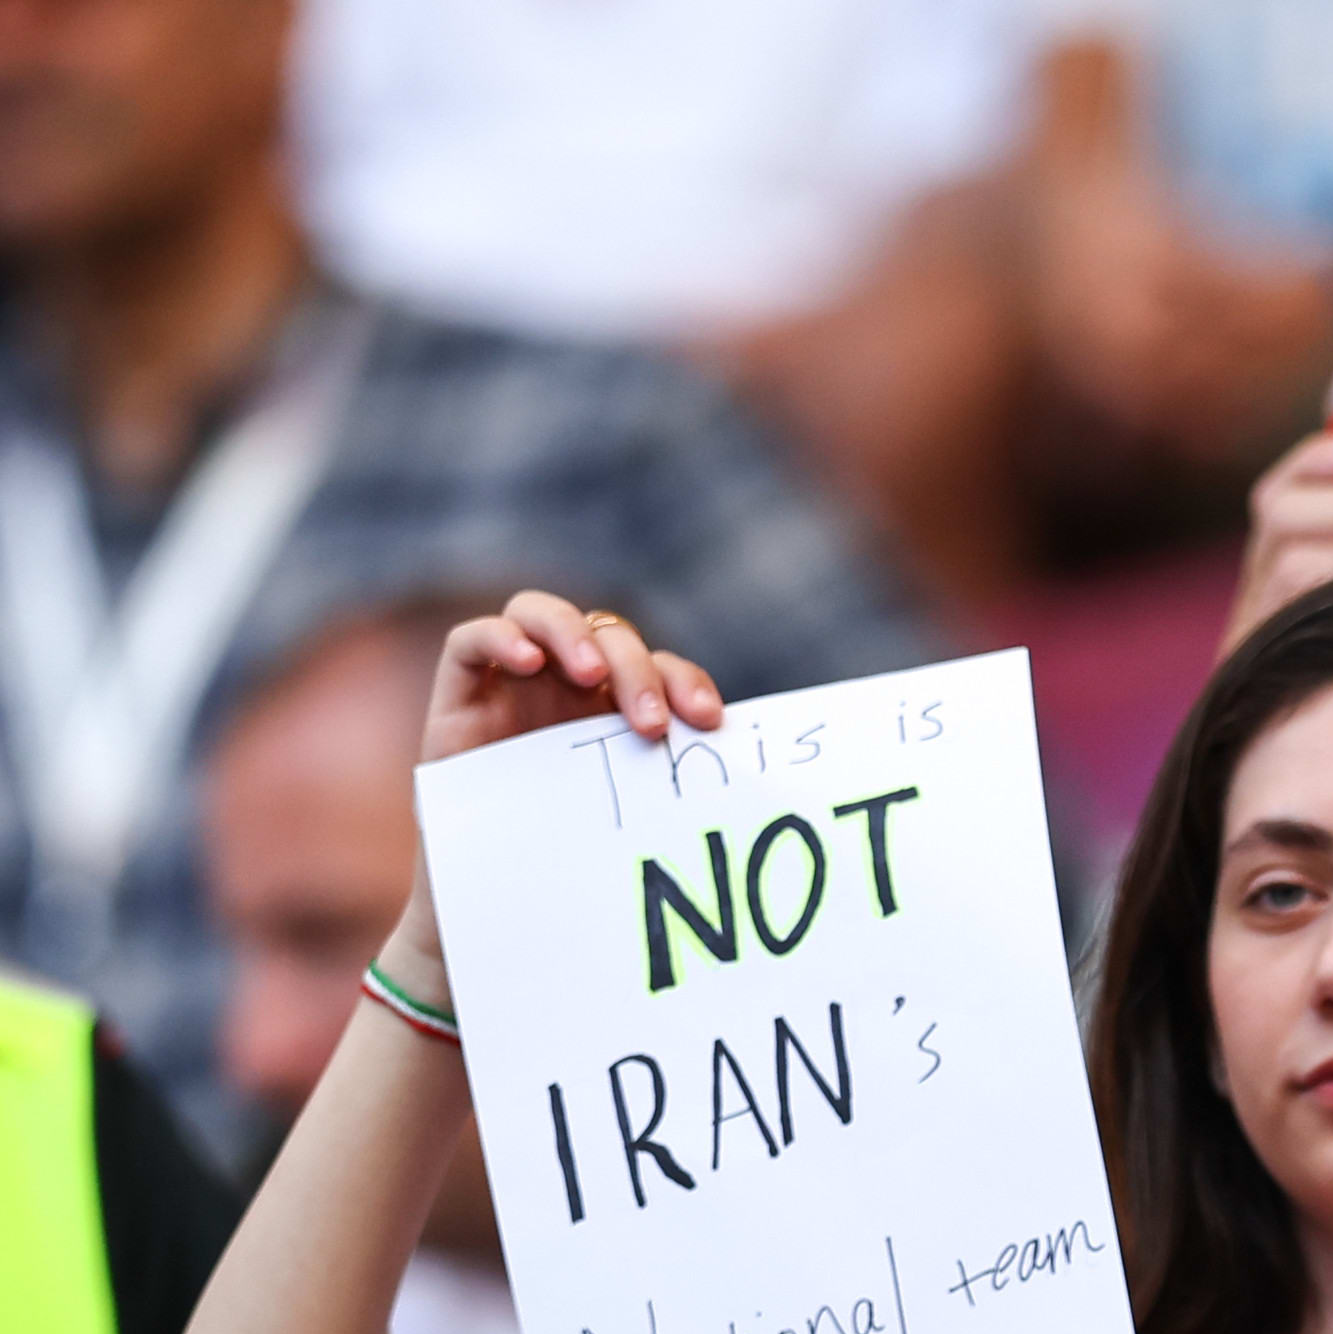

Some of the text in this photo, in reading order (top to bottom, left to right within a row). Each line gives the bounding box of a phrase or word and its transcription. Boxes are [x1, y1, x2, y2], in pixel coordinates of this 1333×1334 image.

[571, 700, 945, 831] This is
[639, 785, 920, 994] NOT
[547, 996, 943, 1226] IRAN's
[947, 1219, 1106, 1308] team
